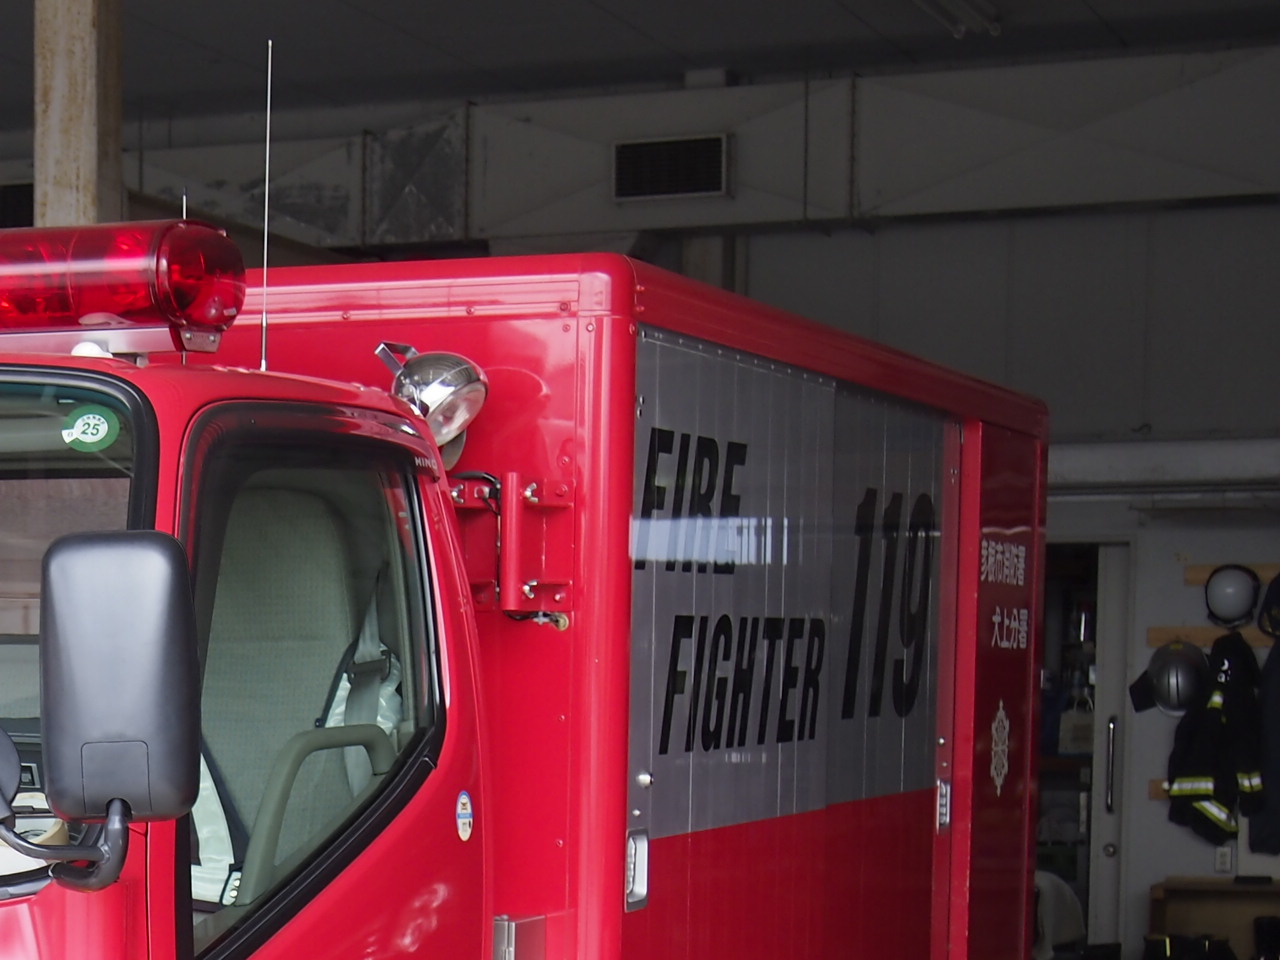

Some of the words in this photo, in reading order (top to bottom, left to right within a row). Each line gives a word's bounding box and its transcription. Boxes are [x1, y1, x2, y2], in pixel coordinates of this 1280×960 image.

[81, 422, 100, 437] 25
[634, 427, 748, 574] FIRE
[841, 487, 936, 720] 119
[991, 605, 1028, 649] 犬上分署
[659, 614, 826, 755] FIGHTER
